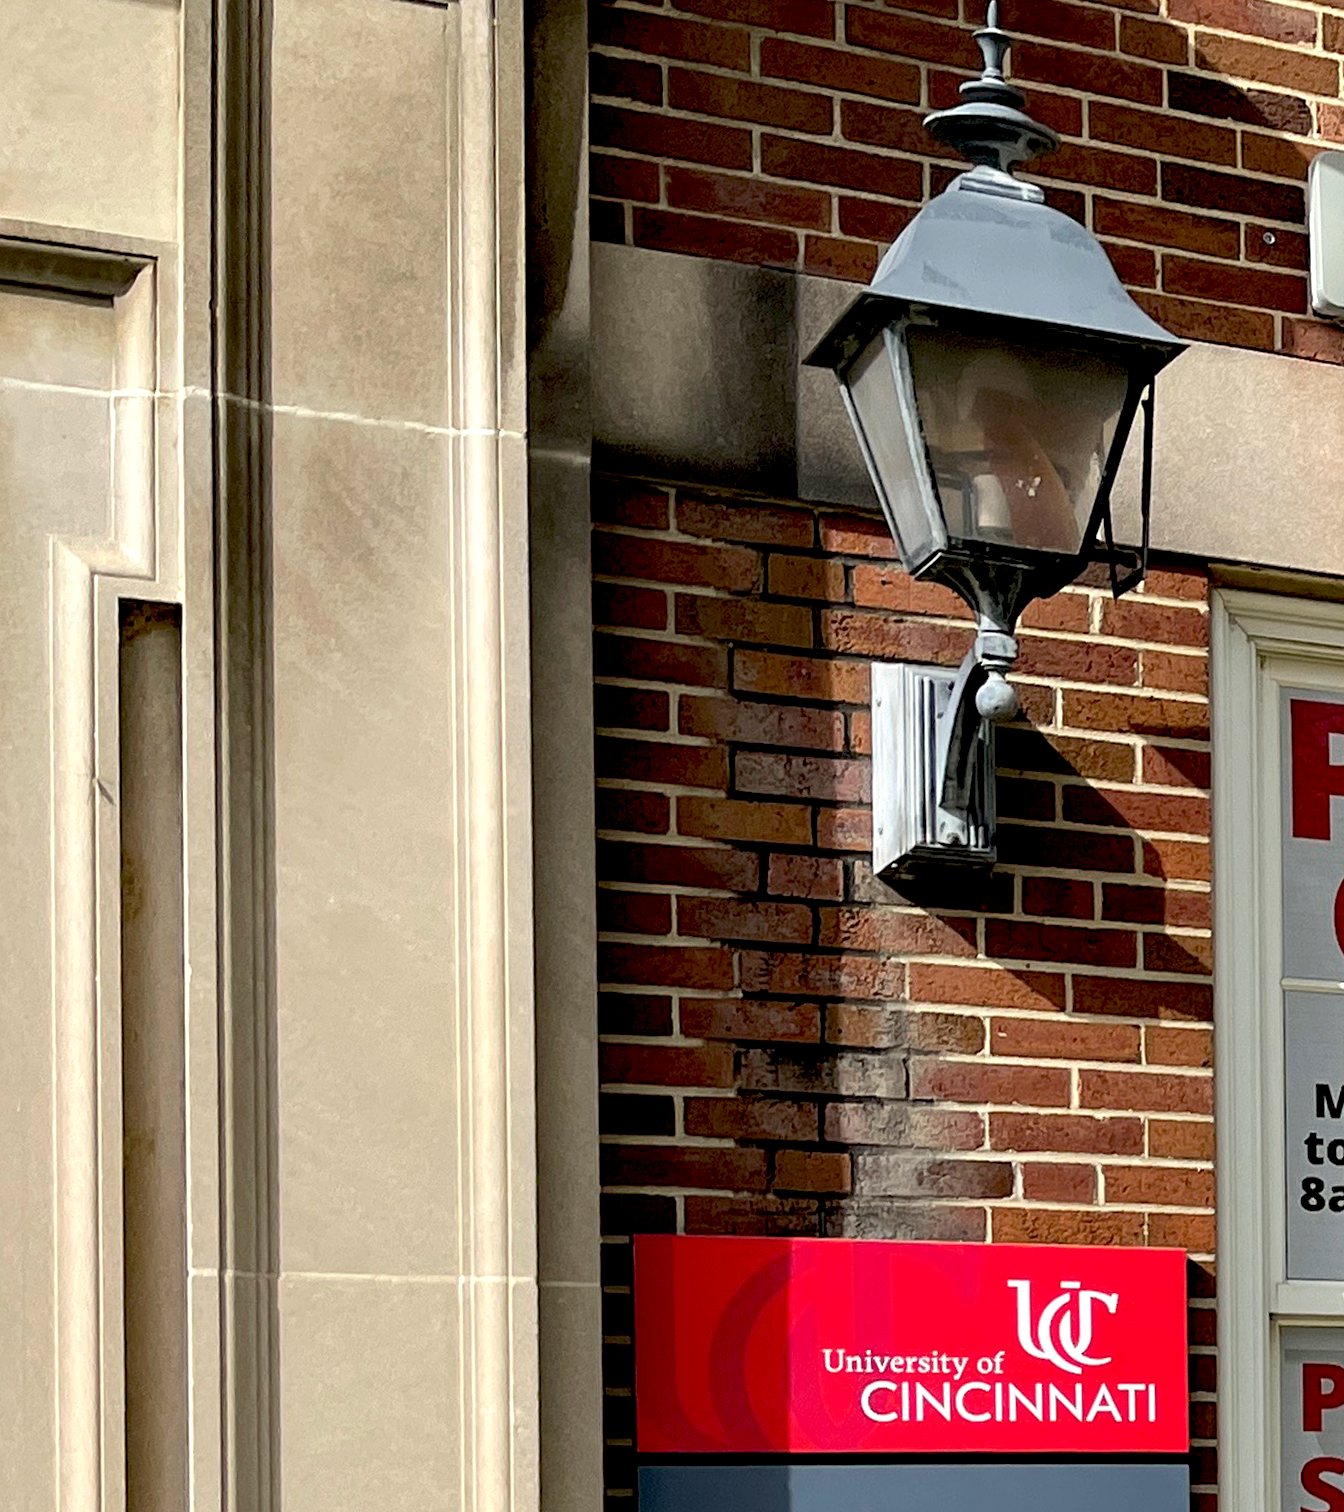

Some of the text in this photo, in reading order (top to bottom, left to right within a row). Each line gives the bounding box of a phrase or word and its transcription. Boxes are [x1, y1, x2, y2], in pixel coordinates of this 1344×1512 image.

[822, 1348, 1005, 1379] University of
[860, 1381, 1157, 1423] CINCINNATI
